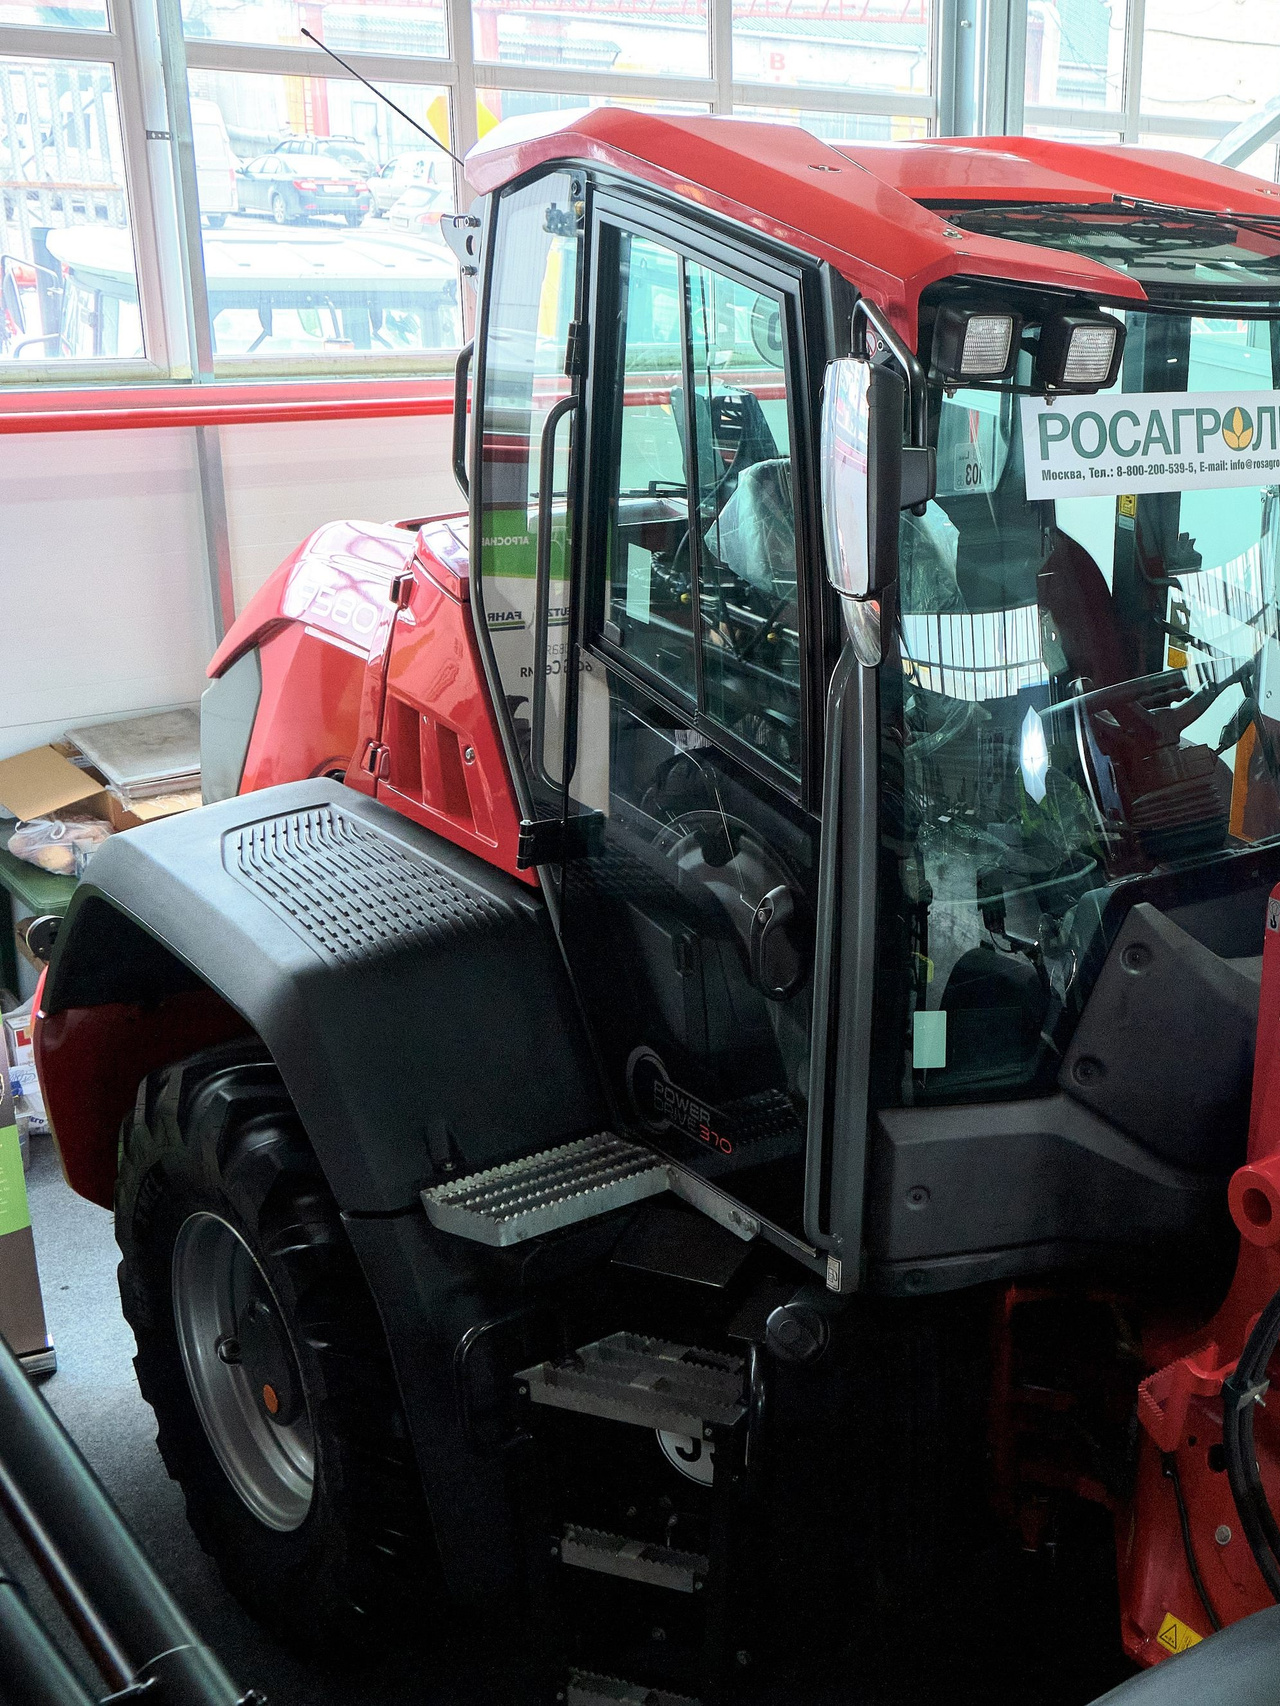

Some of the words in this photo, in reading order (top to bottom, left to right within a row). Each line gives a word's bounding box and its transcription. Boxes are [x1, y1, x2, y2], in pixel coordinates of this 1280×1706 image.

[1042, 469, 1086, 481] Москва,
[1089, 467, 1113, 479] Тел.:
[1117, 462, 1197, 477] 8-800-200-539-5,
[1200, 460, 1228, 473] E-mail:
[654, 1080, 710, 1128] POWER
[700, 1124, 732, 1154] 370
